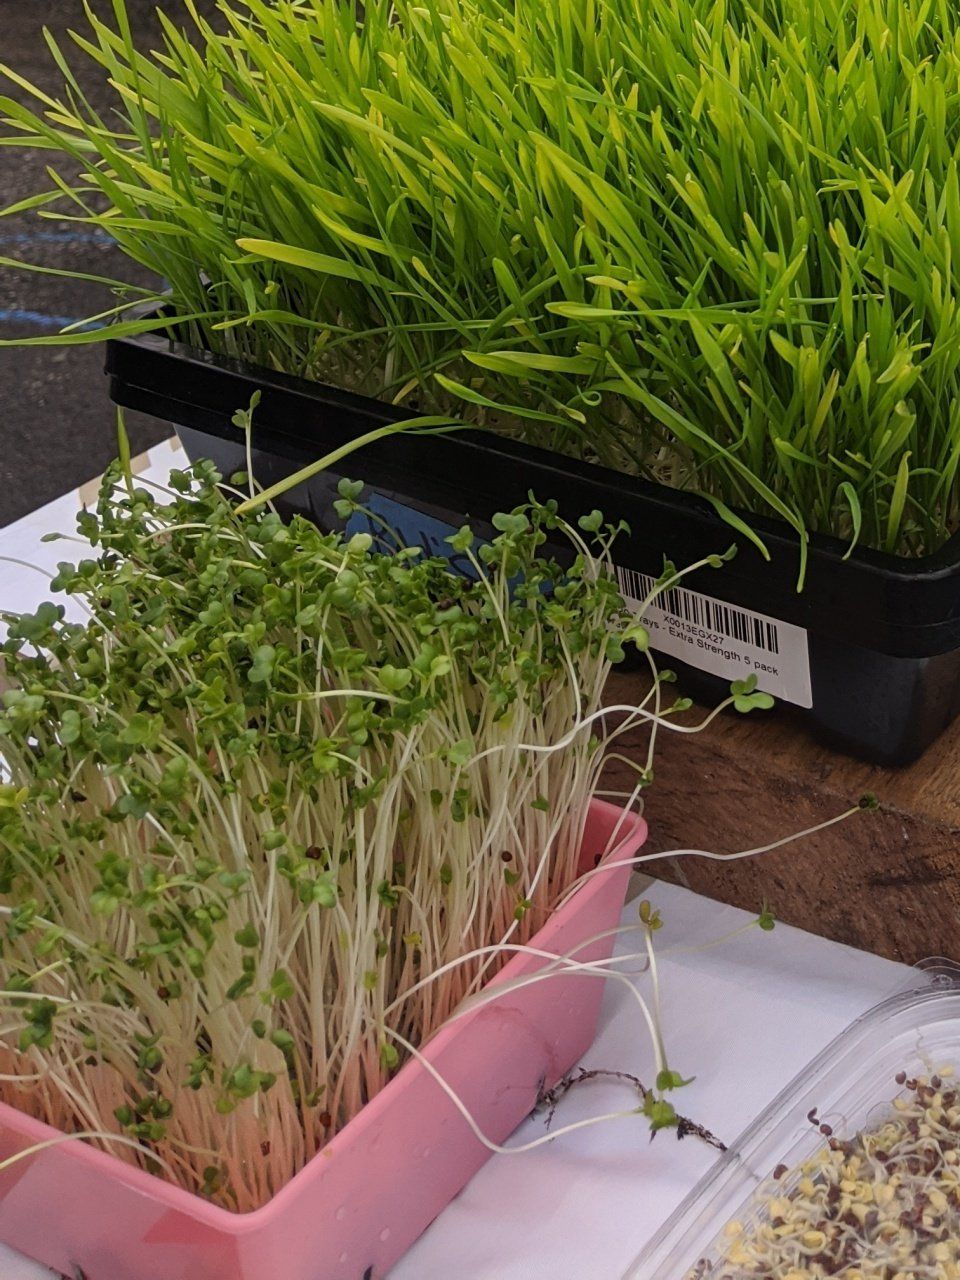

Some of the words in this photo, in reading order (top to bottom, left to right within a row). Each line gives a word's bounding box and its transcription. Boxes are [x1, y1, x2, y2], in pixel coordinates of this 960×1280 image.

[663, 614, 724, 645] X0013EGX27
[669, 626, 694, 644] Extra
[697, 639, 741, 662] Strength
[744, 655, 751, 665] 5
[754, 661, 779, 676] pack
